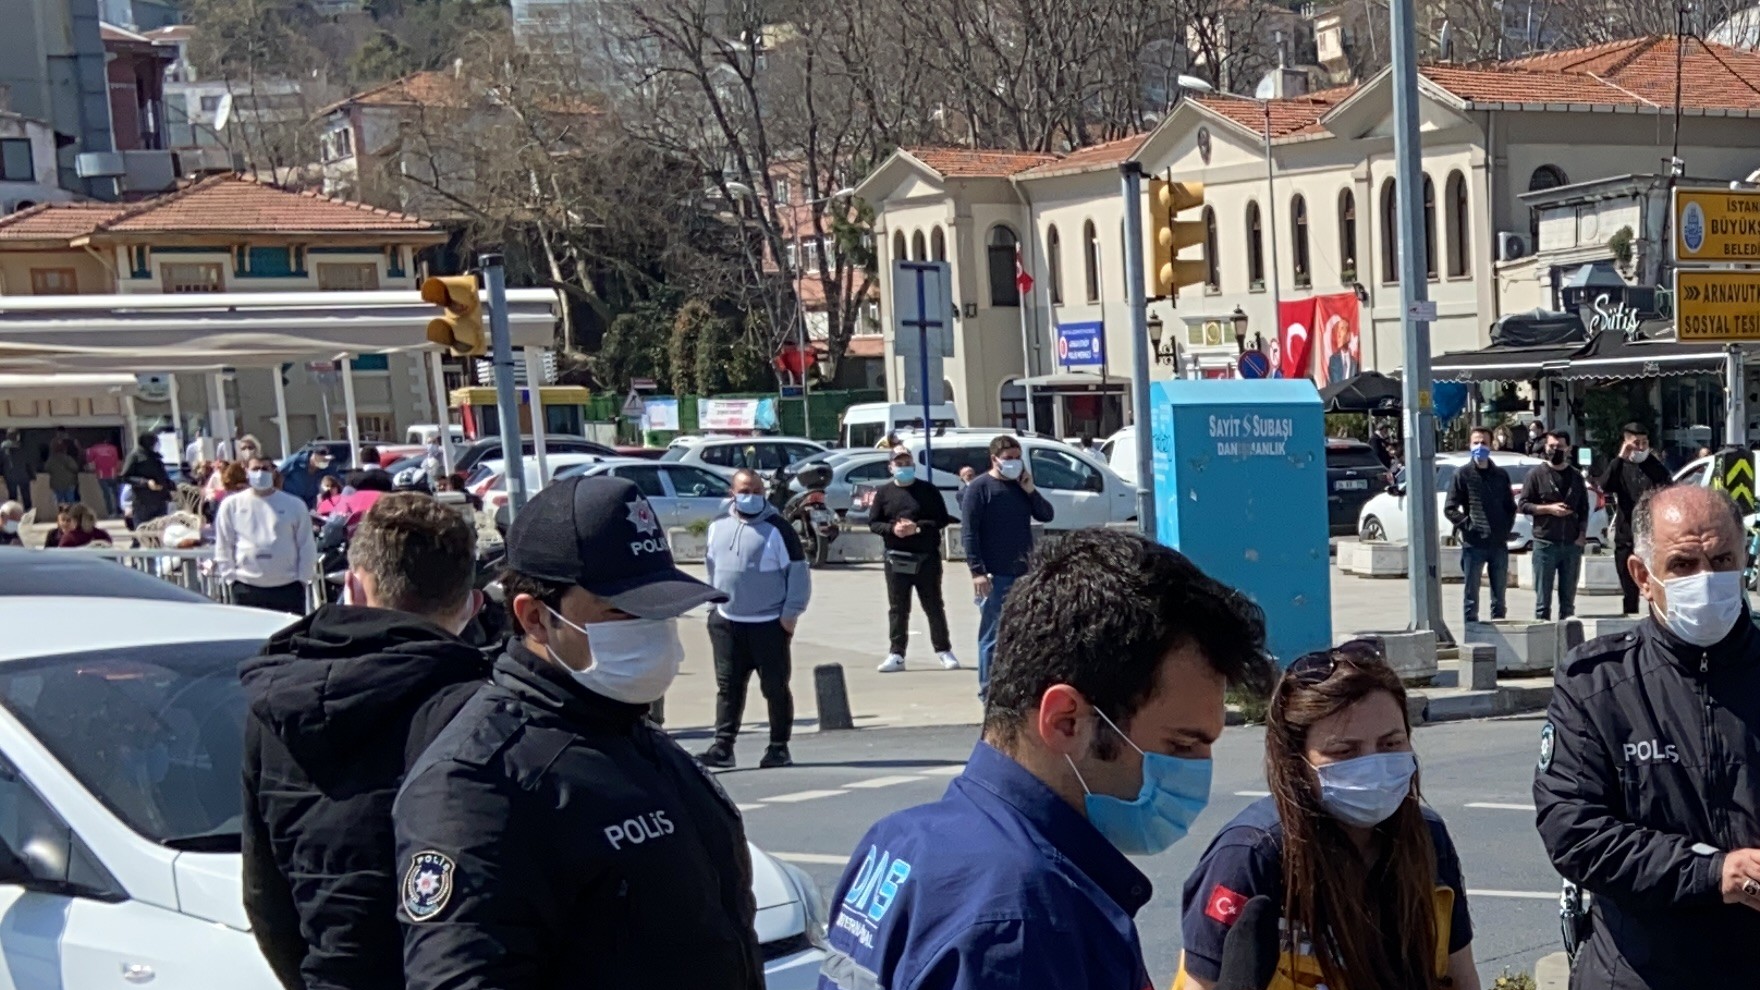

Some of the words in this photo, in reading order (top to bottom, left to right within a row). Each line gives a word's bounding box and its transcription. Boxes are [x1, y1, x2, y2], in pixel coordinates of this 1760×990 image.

[1685, 314, 1730, 334] SOSYAL
[1209, 415, 1240, 437] SAYİT
[1252, 415, 1293, 441] SUBAŞI
[1217, 442, 1286, 456] DANMANLIK
[844, 844, 911, 922] DAS
